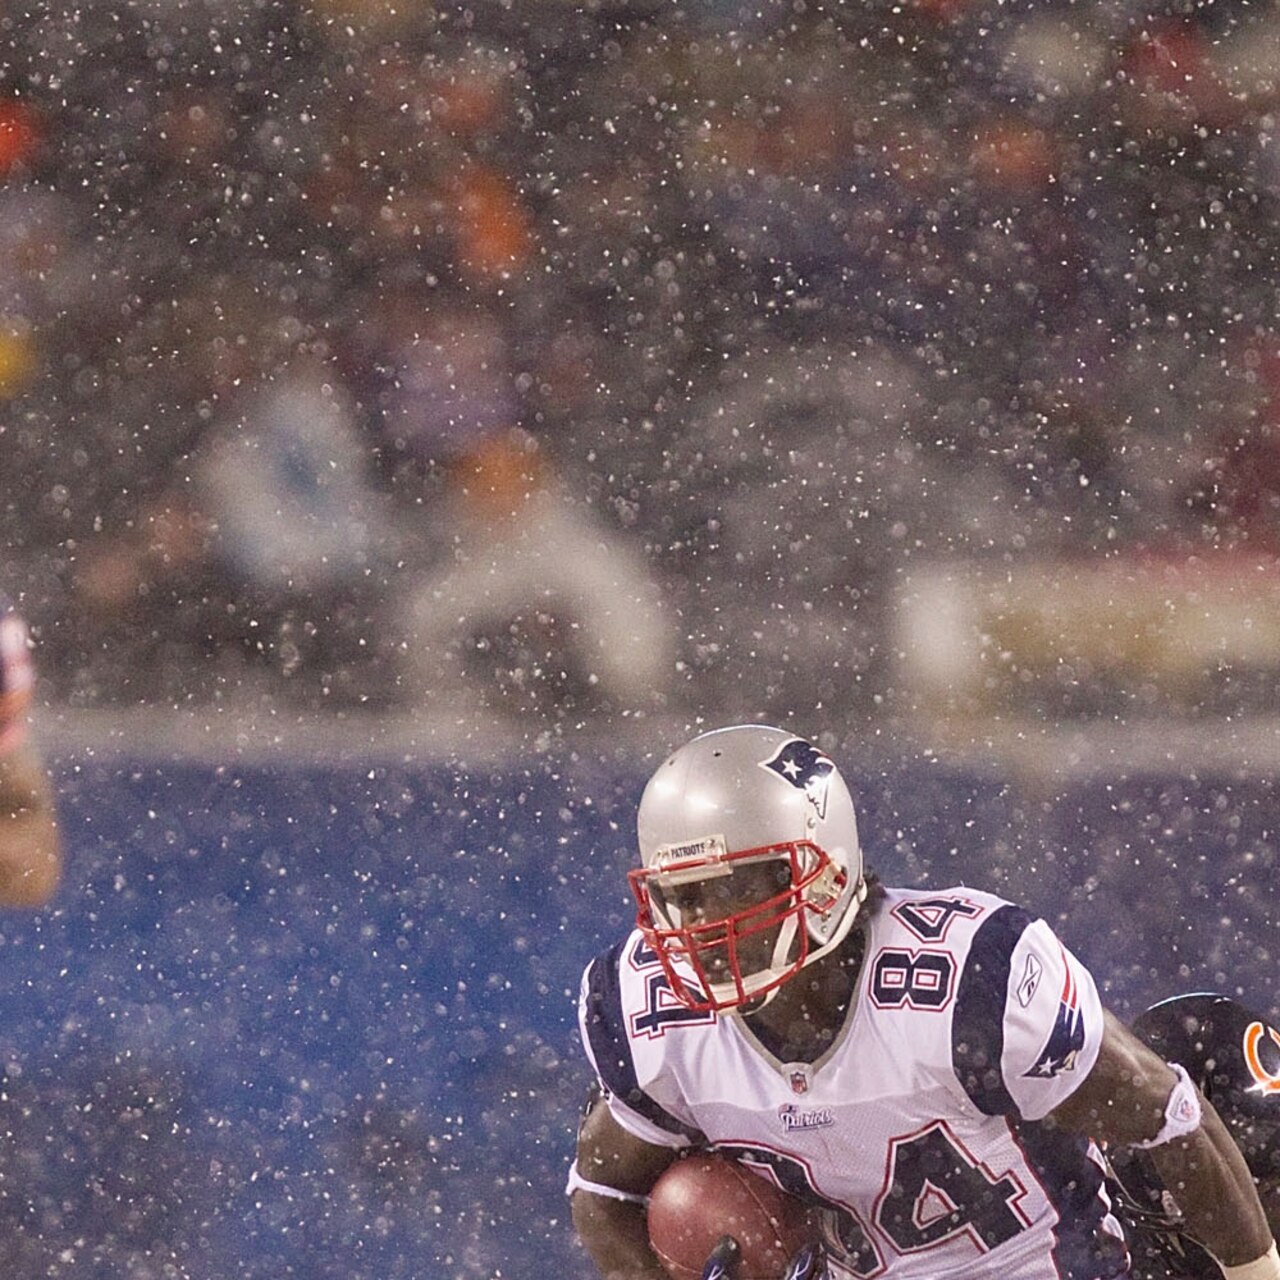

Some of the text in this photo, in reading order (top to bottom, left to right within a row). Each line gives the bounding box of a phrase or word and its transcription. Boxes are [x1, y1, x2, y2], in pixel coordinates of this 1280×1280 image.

[670, 842, 706, 859] PATRIOTS
[868, 896, 985, 1012] 84
[780, 1107, 834, 1136] Patriots
